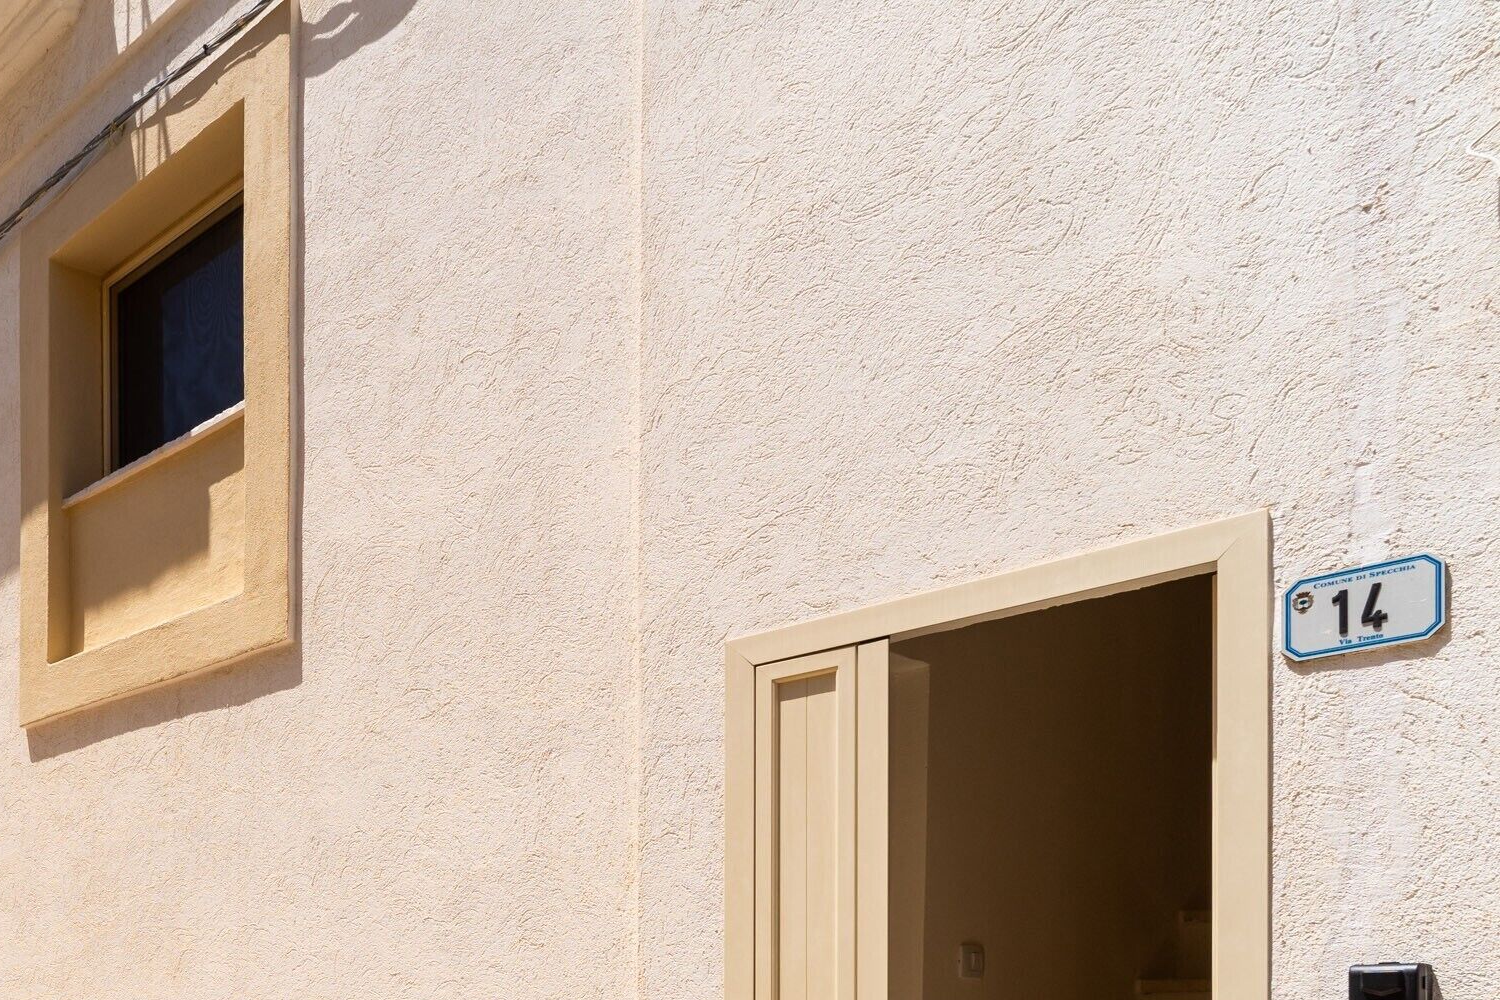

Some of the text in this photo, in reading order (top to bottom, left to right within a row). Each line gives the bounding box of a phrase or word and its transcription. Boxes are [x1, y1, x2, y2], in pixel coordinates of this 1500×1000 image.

[1369, 564, 1416, 578] SPECCHIA
[1331, 582, 1388, 637] 14
[1357, 633, 1384, 642] Trento
